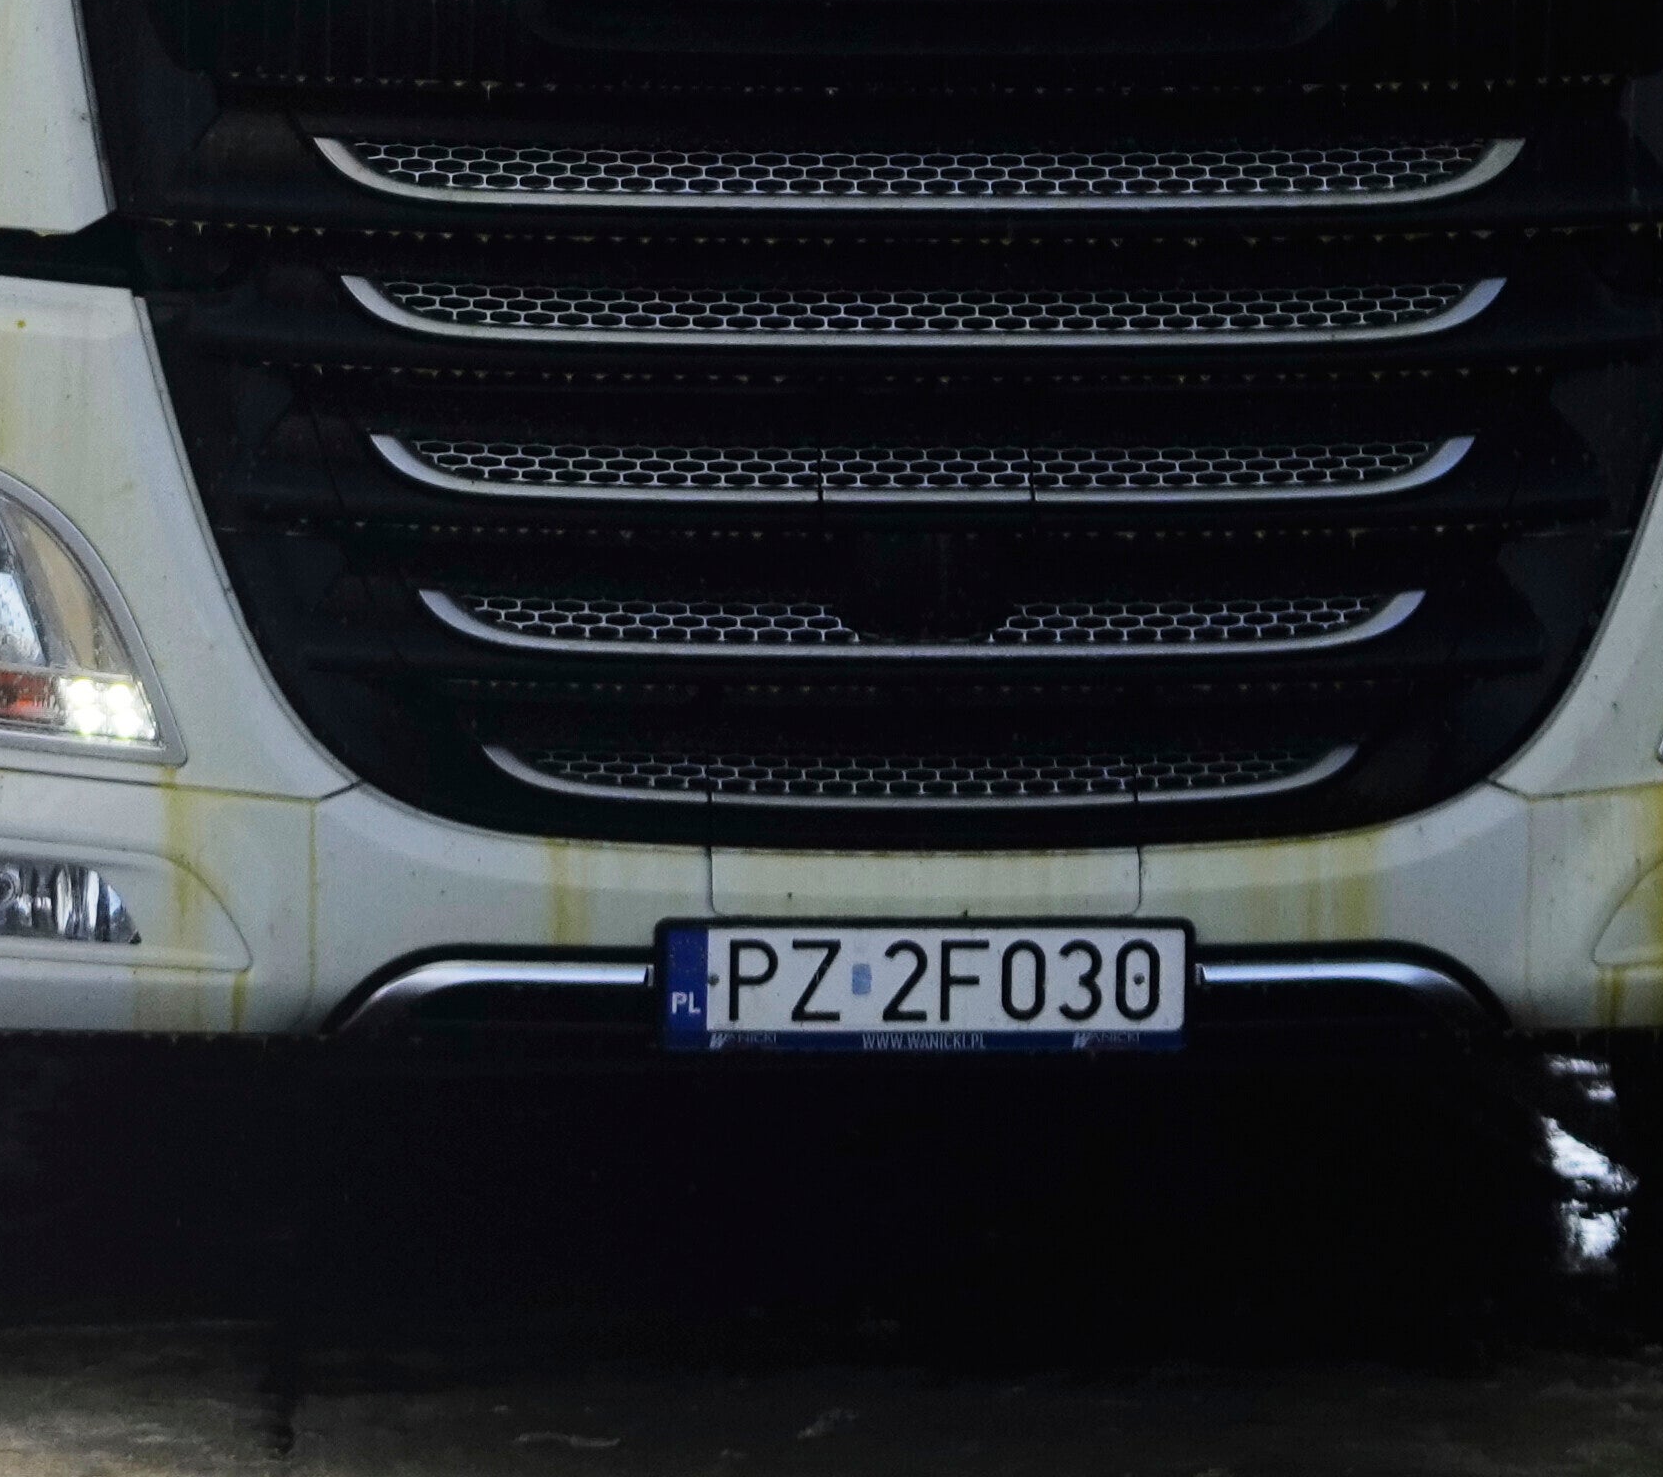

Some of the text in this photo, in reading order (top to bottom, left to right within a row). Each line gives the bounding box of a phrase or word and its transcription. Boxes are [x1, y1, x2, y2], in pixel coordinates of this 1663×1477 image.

[729, 938, 1161, 1022] PZ 2F030
[671, 991, 702, 1015] PL
[862, 1031, 986, 1050] WWW.WANICKI.PL
